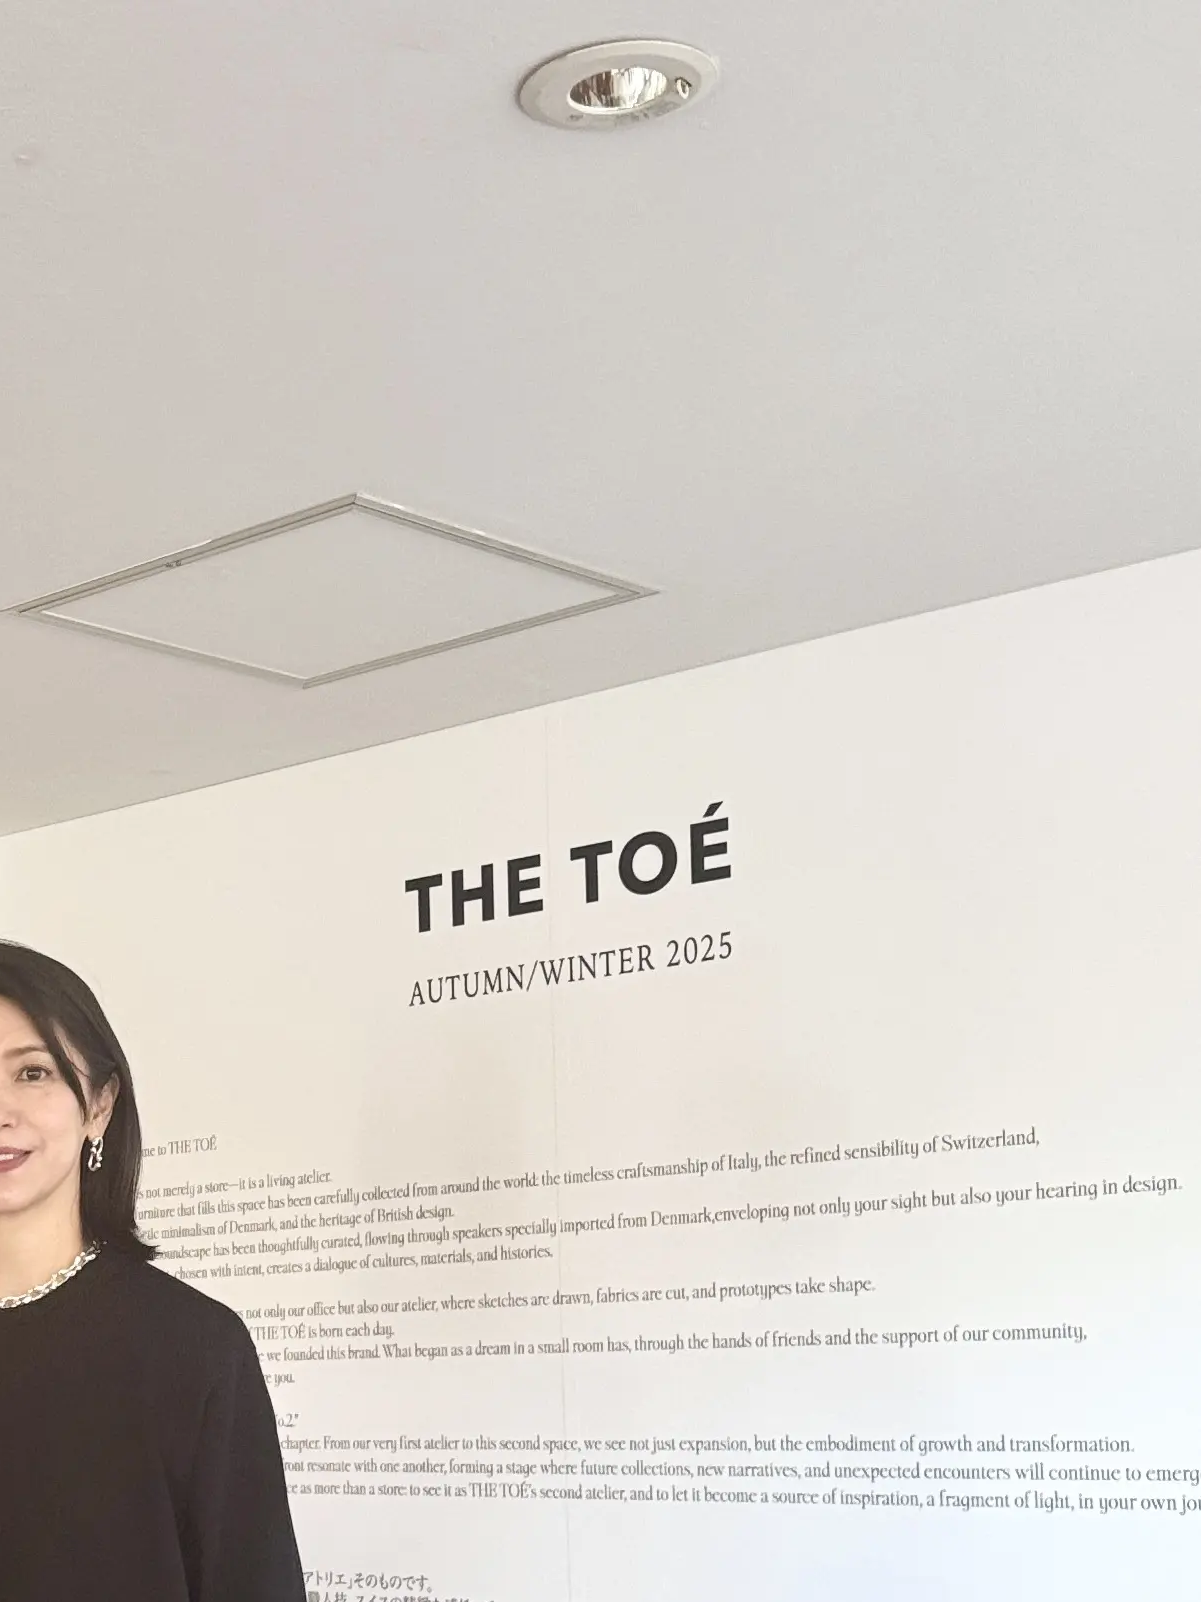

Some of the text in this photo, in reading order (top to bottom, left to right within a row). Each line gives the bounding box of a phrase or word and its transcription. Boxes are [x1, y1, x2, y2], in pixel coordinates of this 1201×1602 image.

[405, 801, 732, 933] THE TOÉ
[408, 931, 733, 1007] AUTUMN/WINTER 2025
[167, 1133, 217, 1155] THE TOÉ
[412, 1125, 1040, 1198] from around world: the timeless craftsmanship of Italy, the refined sensibility of Switzerland,
[377, 1205, 414, 1223] British
[407, 1225, 450, 1246] through
[452, 1222, 503, 1245] speakers
[504, 1217, 557, 1241] specially
[559, 1212, 616, 1236] imported
[617, 1211, 648, 1229] from
[793, 1201, 816, 1217] not
[818, 1195, 851, 1218] only
[854, 1198, 889, 1217] your
[890, 1190, 928, 1214] sight
[931, 1189, 956, 1207] but
[960, 1186, 992, 1205] also
[995, 1188, 1033, 1208] your
[1035, 1180, 1098, 1201] hearing
[1102, 1178, 1118, 1196] in
[1122, 1174, 1183, 1197] design.
[500, 1244, 554, 1261] histories.
[440, 1294, 476, 1311] where
[477, 1291, 529, 1309] sketches
[530, 1295, 550, 1307] are
[552, 1289, 594, 1307] drawn,
[596, 1286, 640, 1304] fabrics
[641, 1289, 663, 1302] are
[665, 1287, 690, 1302] cut,
[691, 1281, 717, 1300] and
[719, 1283, 793, 1303] prototypes
[795, 1276, 826, 1295] take
[828, 1275, 876, 1297] shape.
[254, 1323, 279, 1341] THE
[279, 1321, 306, 1340] TOÉ
[308, 1325, 318, 1339] is
[318, 1322, 344, 1339] born
[345, 1321, 371, 1337] each
[381, 1322, 1088, 1361] What began dream small room has, through the hands of friends and the support of our community,
[275, 1412, 299, 1428] o.2"
[399, 1433, 1135, 1457] first atelier this second space, see not just expansion, but the embodiment of growth and transformation.
[449, 1457, 494, 1479] forming
[505, 1461, 538, 1479] stage
[539, 1458, 578, 1476] where
[580, 1458, 618, 1476] future
[620, 1459, 694, 1479] collections,
[697, 1465, 726, 1477] new
[727, 1462, 802, 1480] narratives,
[804, 1460, 831, 1478] and
[834, 1461, 921, 1484] unexpected
[923, 1466, 1011, 1481] encounters
[1014, 1461, 1045, 1481] will
[1048, 1464, 1121, 1481] continue
[1125, 1467, 1142, 1481] to
[539, 1483, 583, 1500] second
[585, 1483, 628, 1503] atelier,
[629, 1484, 654, 1501] and
[656, 1488, 669, 1501] to
[671, 1484, 689, 1502] let
[691, 1487, 702, 1503] it
[703, 1485, 758, 1504] become
[760, 1491, 770, 1504] a
[771, 1491, 820, 1505] source
[822, 1487, 837, 1505] of
[840, 1489, 924, 1511] inspiration,
[926, 1494, 935, 1507] a
[939, 1488, 1010, 1512] fragment
[1014, 1489, 1031, 1509] of
[1034, 1490, 1075, 1514] light,
[1078, 1492, 1094, 1510] in
[1098, 1497, 1138, 1515] your
[1140, 1498, 1178, 1511] own
